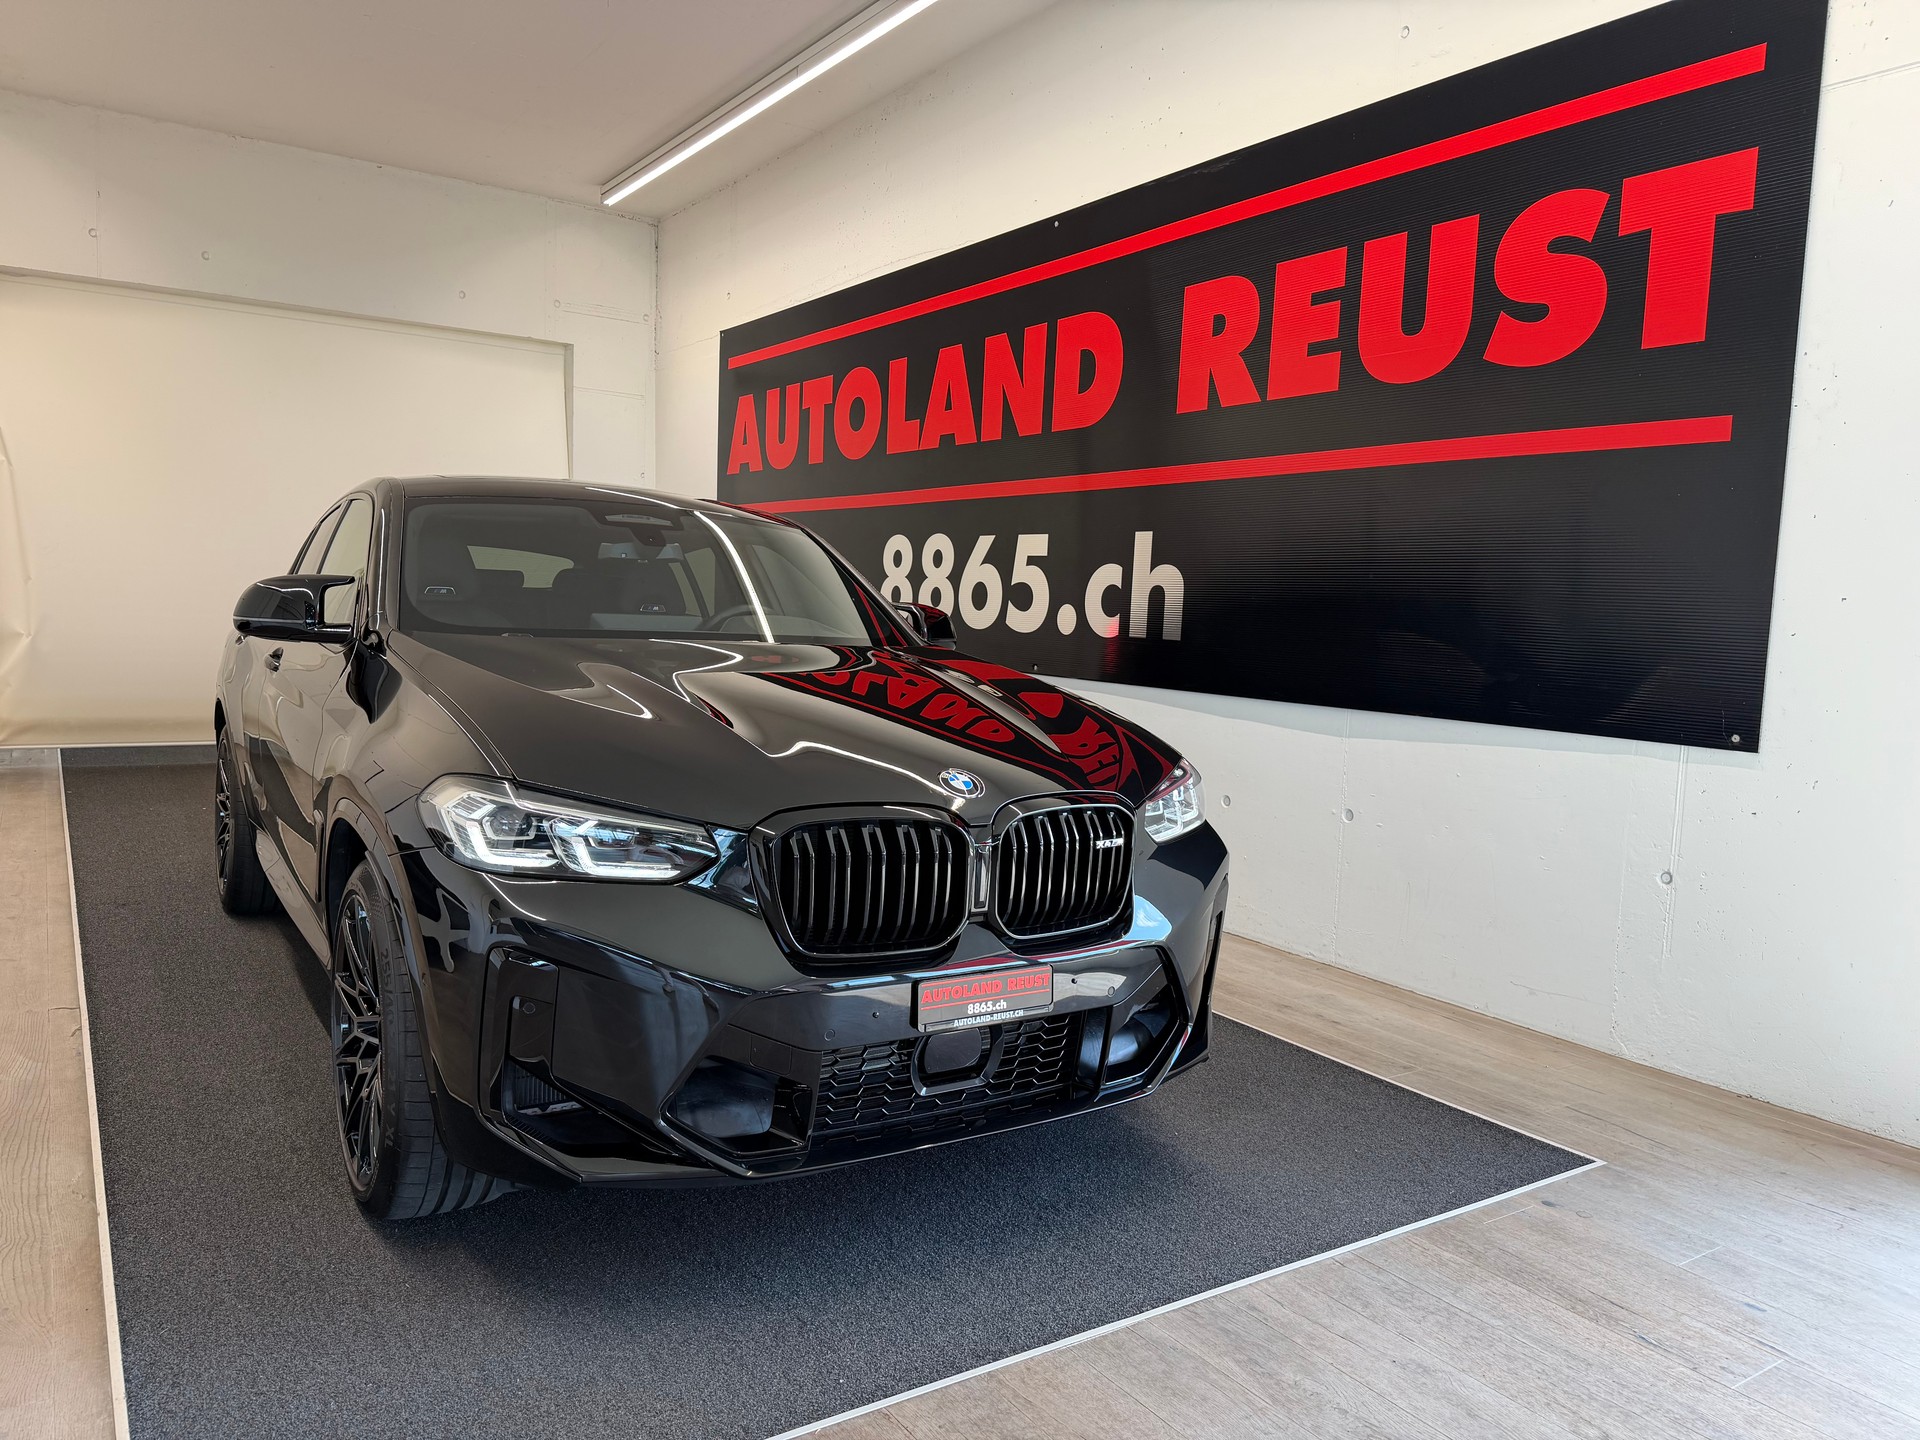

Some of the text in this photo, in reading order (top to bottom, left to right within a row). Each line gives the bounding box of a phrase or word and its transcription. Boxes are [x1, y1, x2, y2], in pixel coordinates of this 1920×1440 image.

[727, 147, 1759, 475] AUTOLAND REUST
[879, 530, 1185, 641] 8865.ch
[921, 973, 1051, 1004] AUTOLAND REUST
[953, 1010, 1024, 1027] AUTOLAND-REUST.CH
[967, 1000, 1007, 1015] 8865.ch
